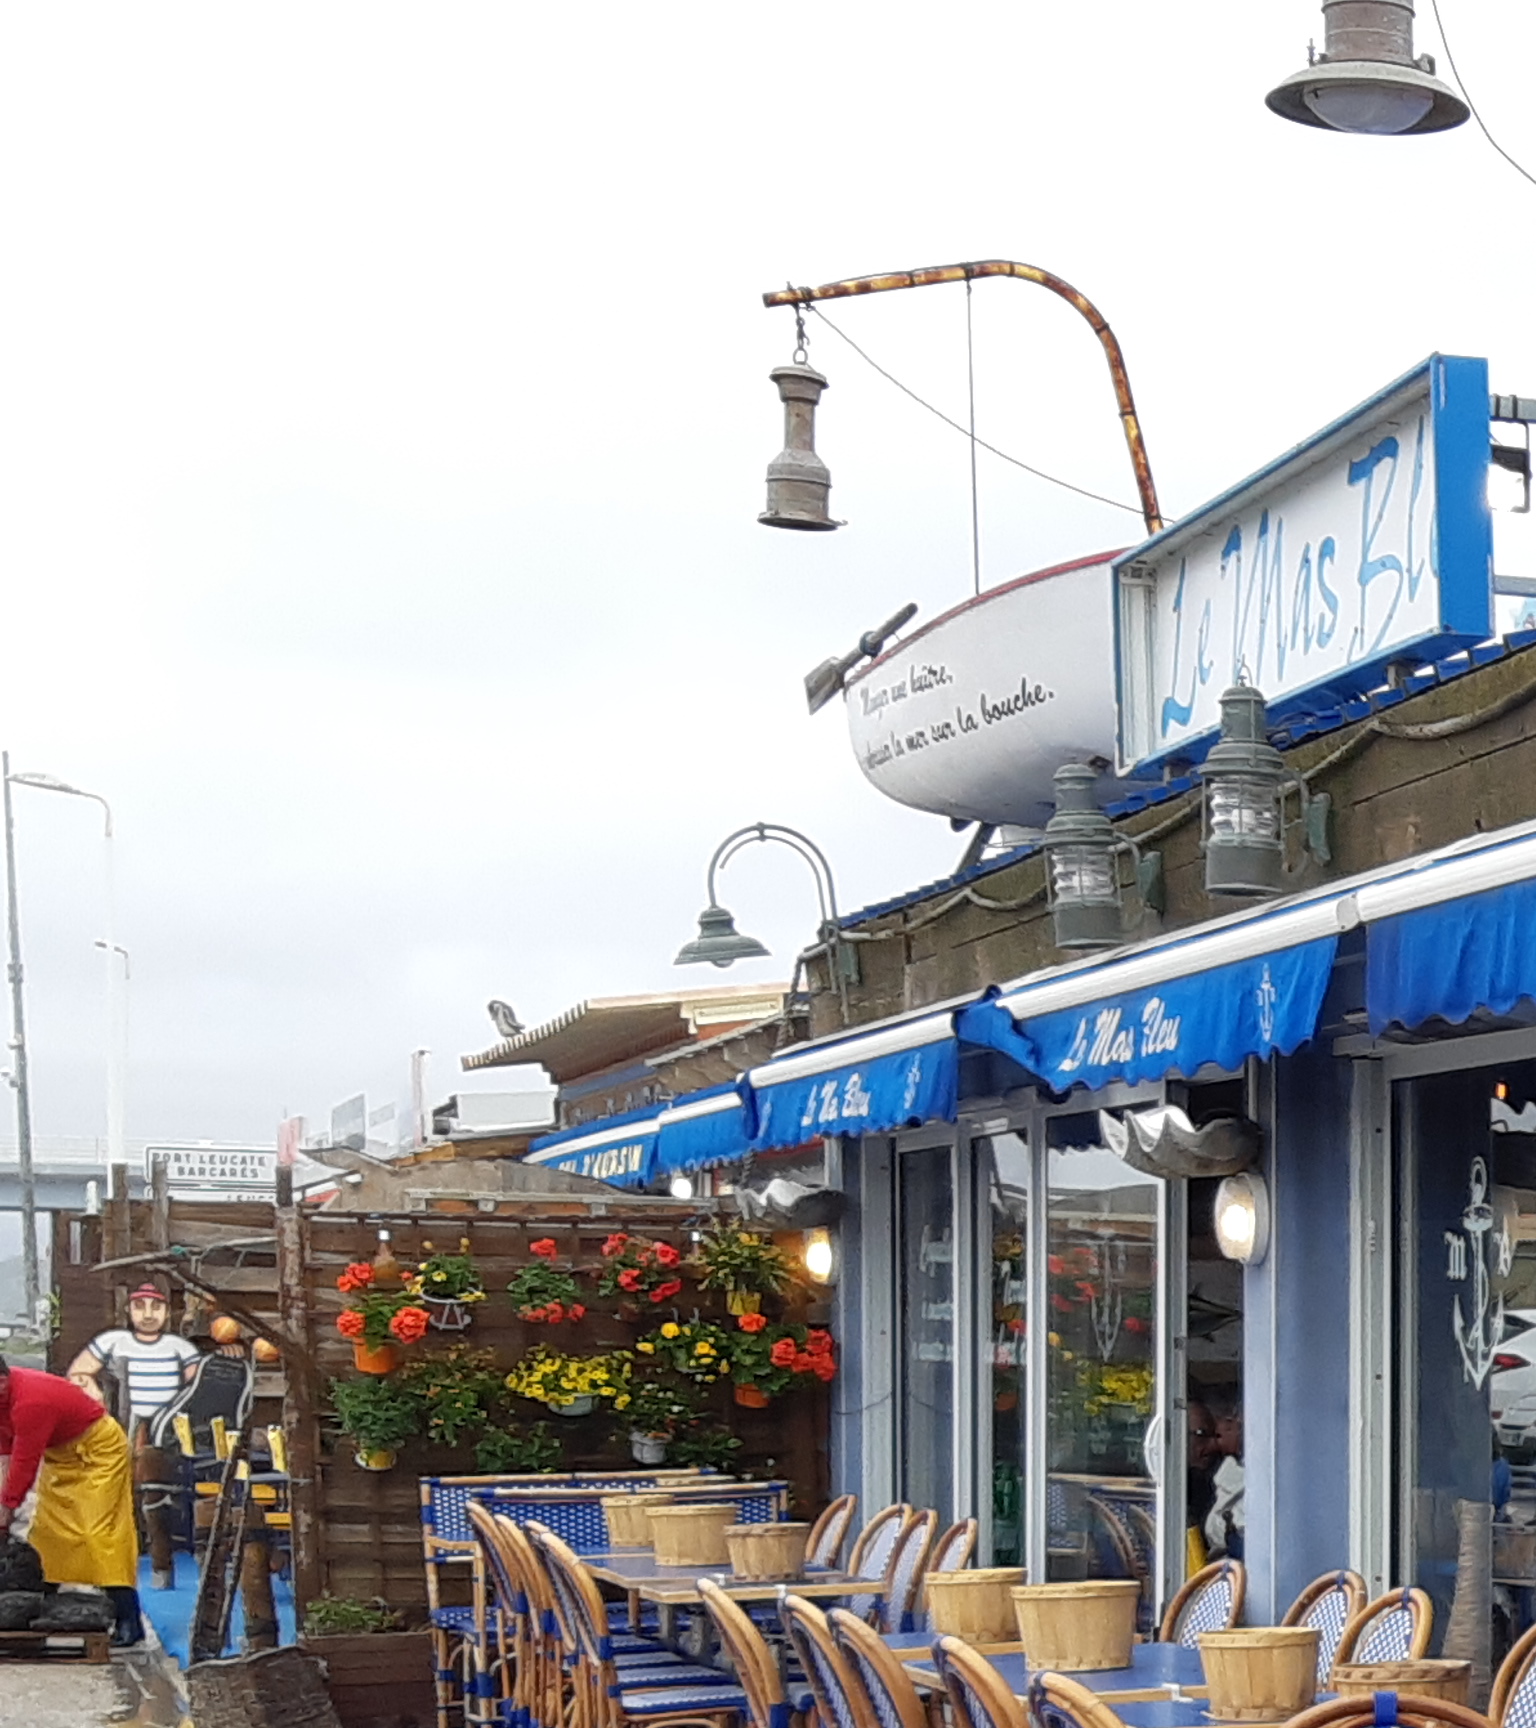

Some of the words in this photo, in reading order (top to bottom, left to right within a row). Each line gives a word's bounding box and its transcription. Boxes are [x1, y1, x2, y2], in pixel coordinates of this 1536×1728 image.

[1162, 557, 1214, 738] Le
[1221, 508, 1338, 686] Mas
[956, 705, 979, 733] la
[980, 676, 1054, 725] bouche.
[199, 1154, 267, 1167] LEUCATE
